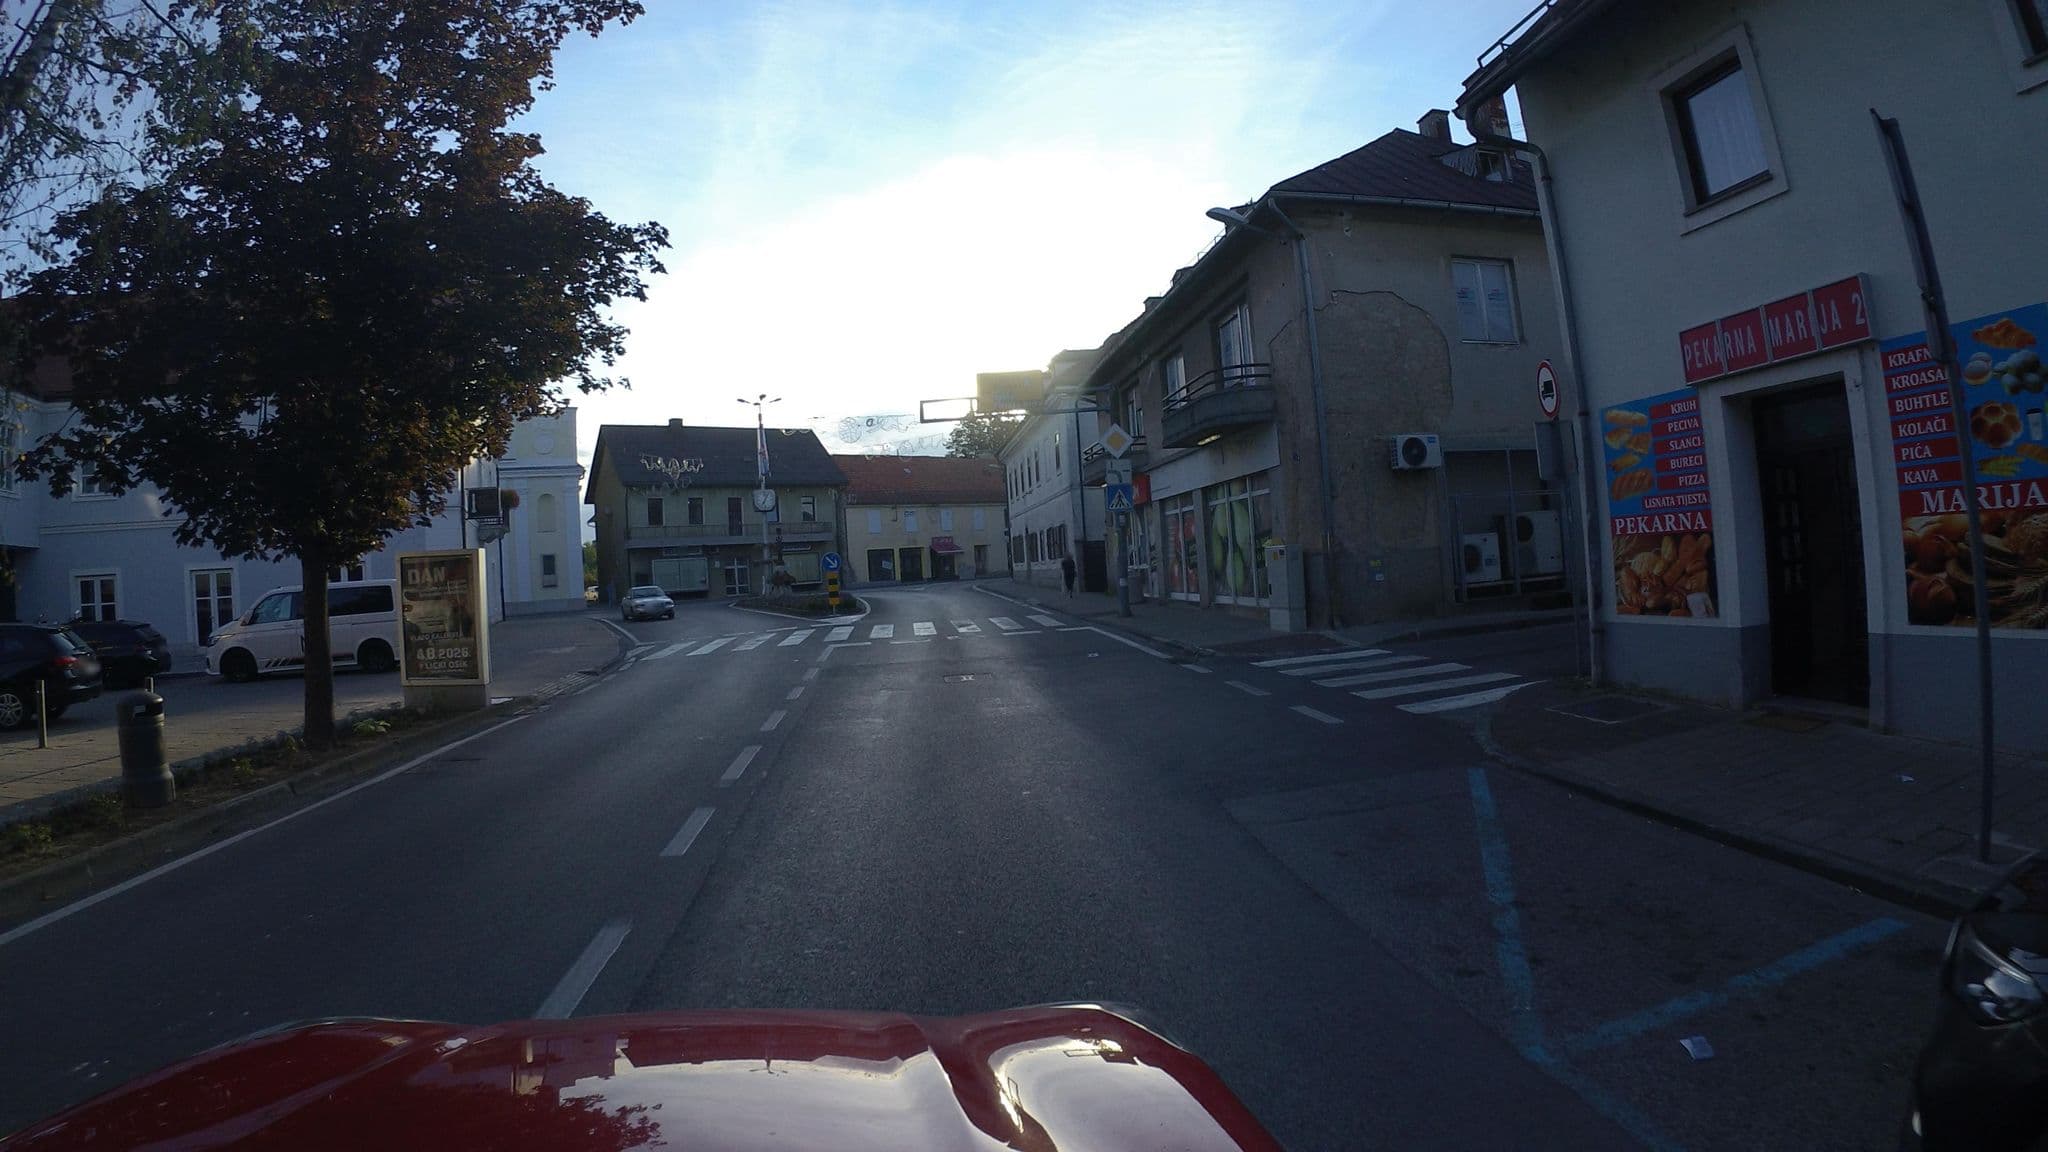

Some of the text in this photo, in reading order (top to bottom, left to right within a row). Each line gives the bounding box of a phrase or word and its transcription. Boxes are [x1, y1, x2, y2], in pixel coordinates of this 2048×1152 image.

[1684, 291, 1866, 371] PEKARNA MARIJA 2
[1888, 347, 1933, 368] KRAFN
[1670, 400, 1697, 415] KRUH
[1895, 391, 1949, 412] BUHTLE
[1668, 417, 1699, 433] PECIVA
[1898, 415, 1946, 438] KOLAČI
[1668, 436, 1702, 451] SLANCI
[1901, 443, 1932, 461] PIĆA
[1670, 455, 1703, 469] BURECI
[1678, 474, 1705, 487] PIZZA
[1904, 469, 1938, 485] KAVA
[1644, 493, 1708, 509] LISNATA TIJESTA
[1921, 481, 2048, 514] MARIJA
[1615, 511, 1707, 535] PEKARNA
